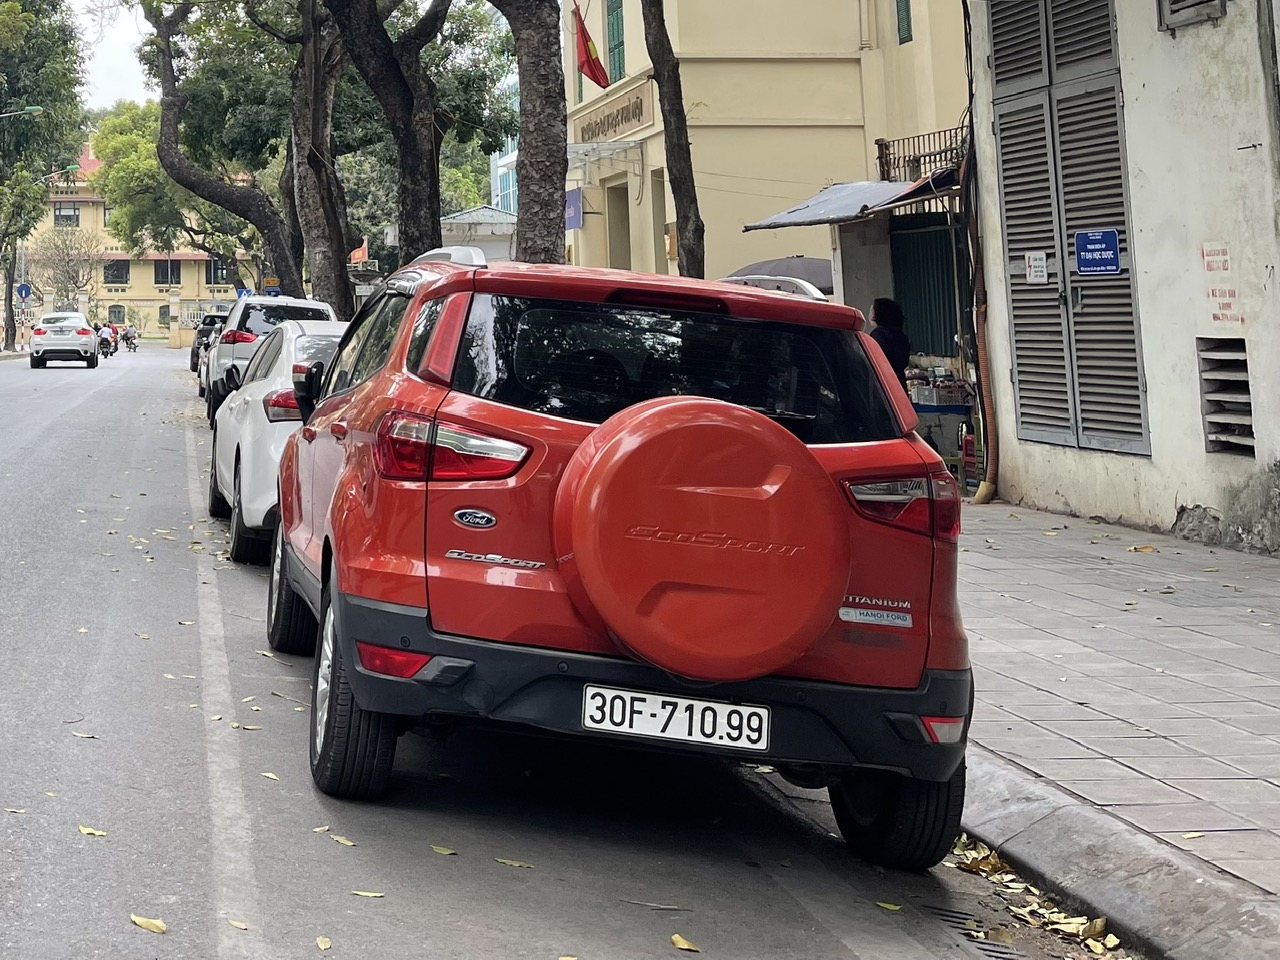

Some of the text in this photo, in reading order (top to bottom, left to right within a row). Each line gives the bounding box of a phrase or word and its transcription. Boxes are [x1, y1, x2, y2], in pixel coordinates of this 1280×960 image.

[462, 513, 487, 524] Ford
[859, 611, 908, 622] HANOI FORD
[589, 692, 763, 745] 30F-710.99
